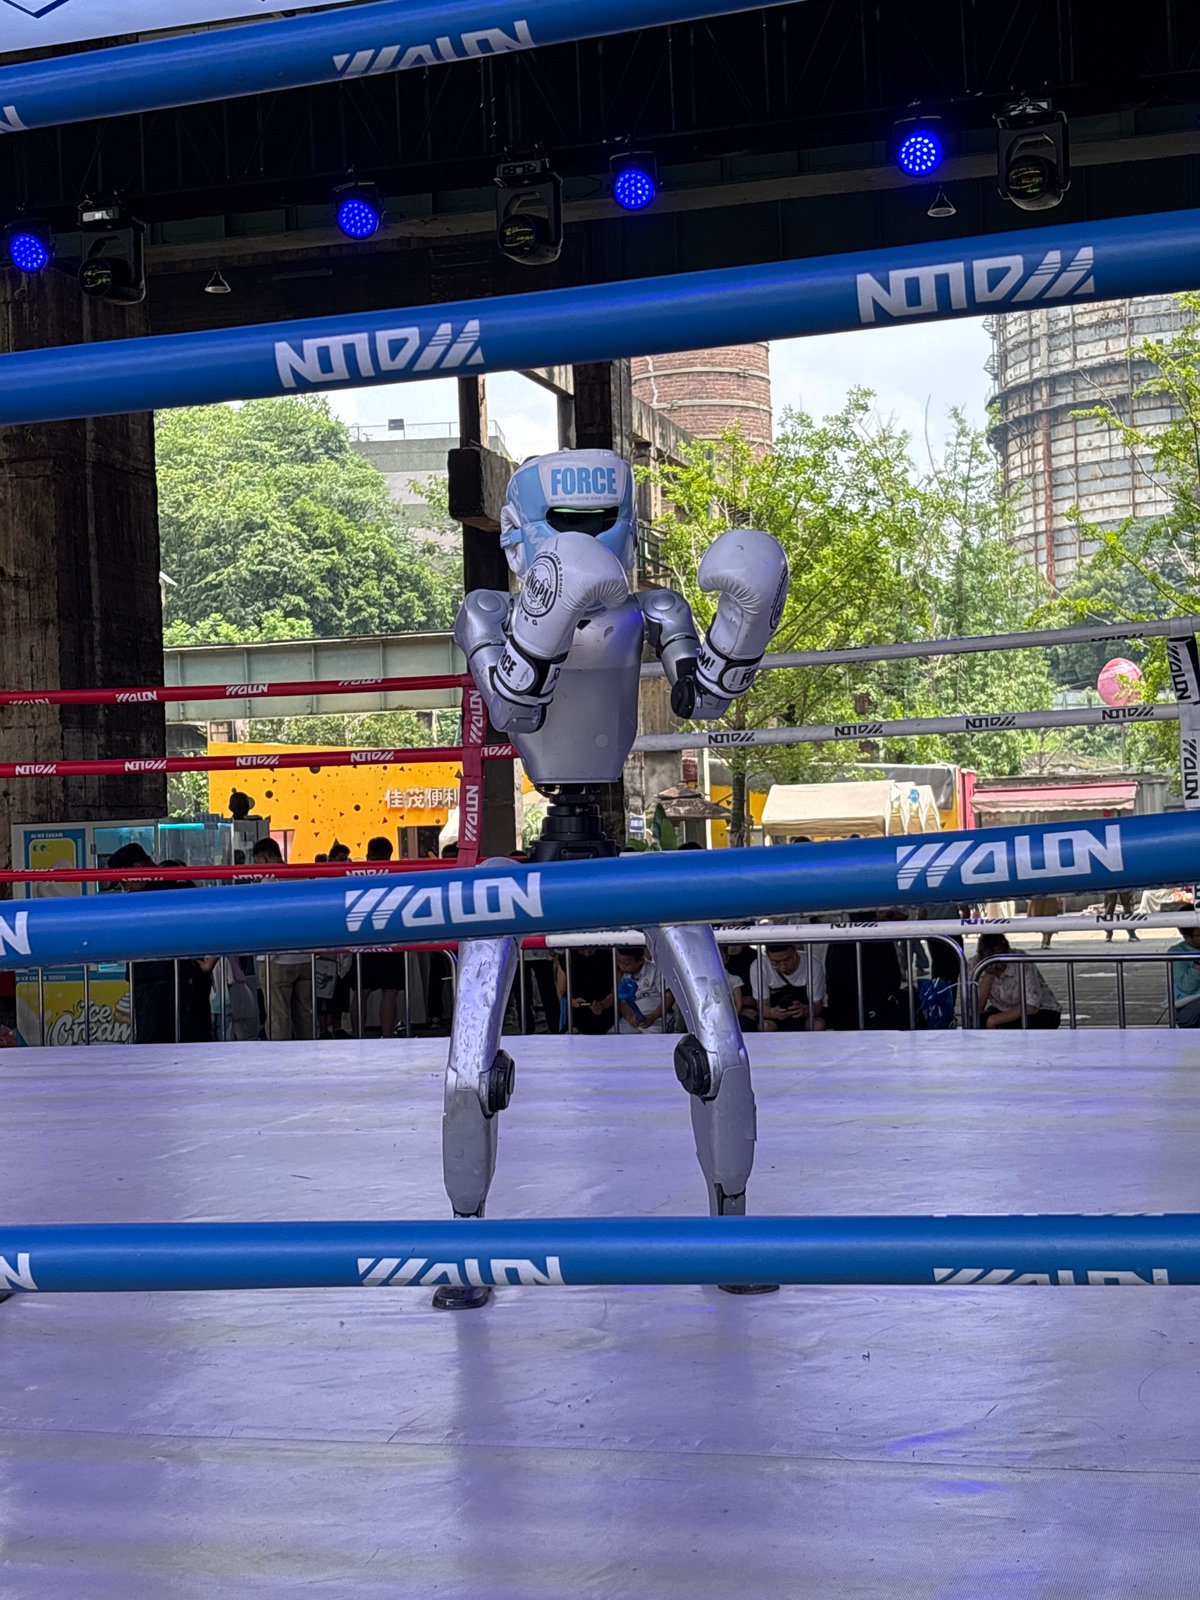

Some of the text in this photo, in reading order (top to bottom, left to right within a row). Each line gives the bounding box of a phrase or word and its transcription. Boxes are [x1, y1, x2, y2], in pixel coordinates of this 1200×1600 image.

[551, 467, 617, 496] FORCE
[384, 787, 459, 808] 佳茂便利
